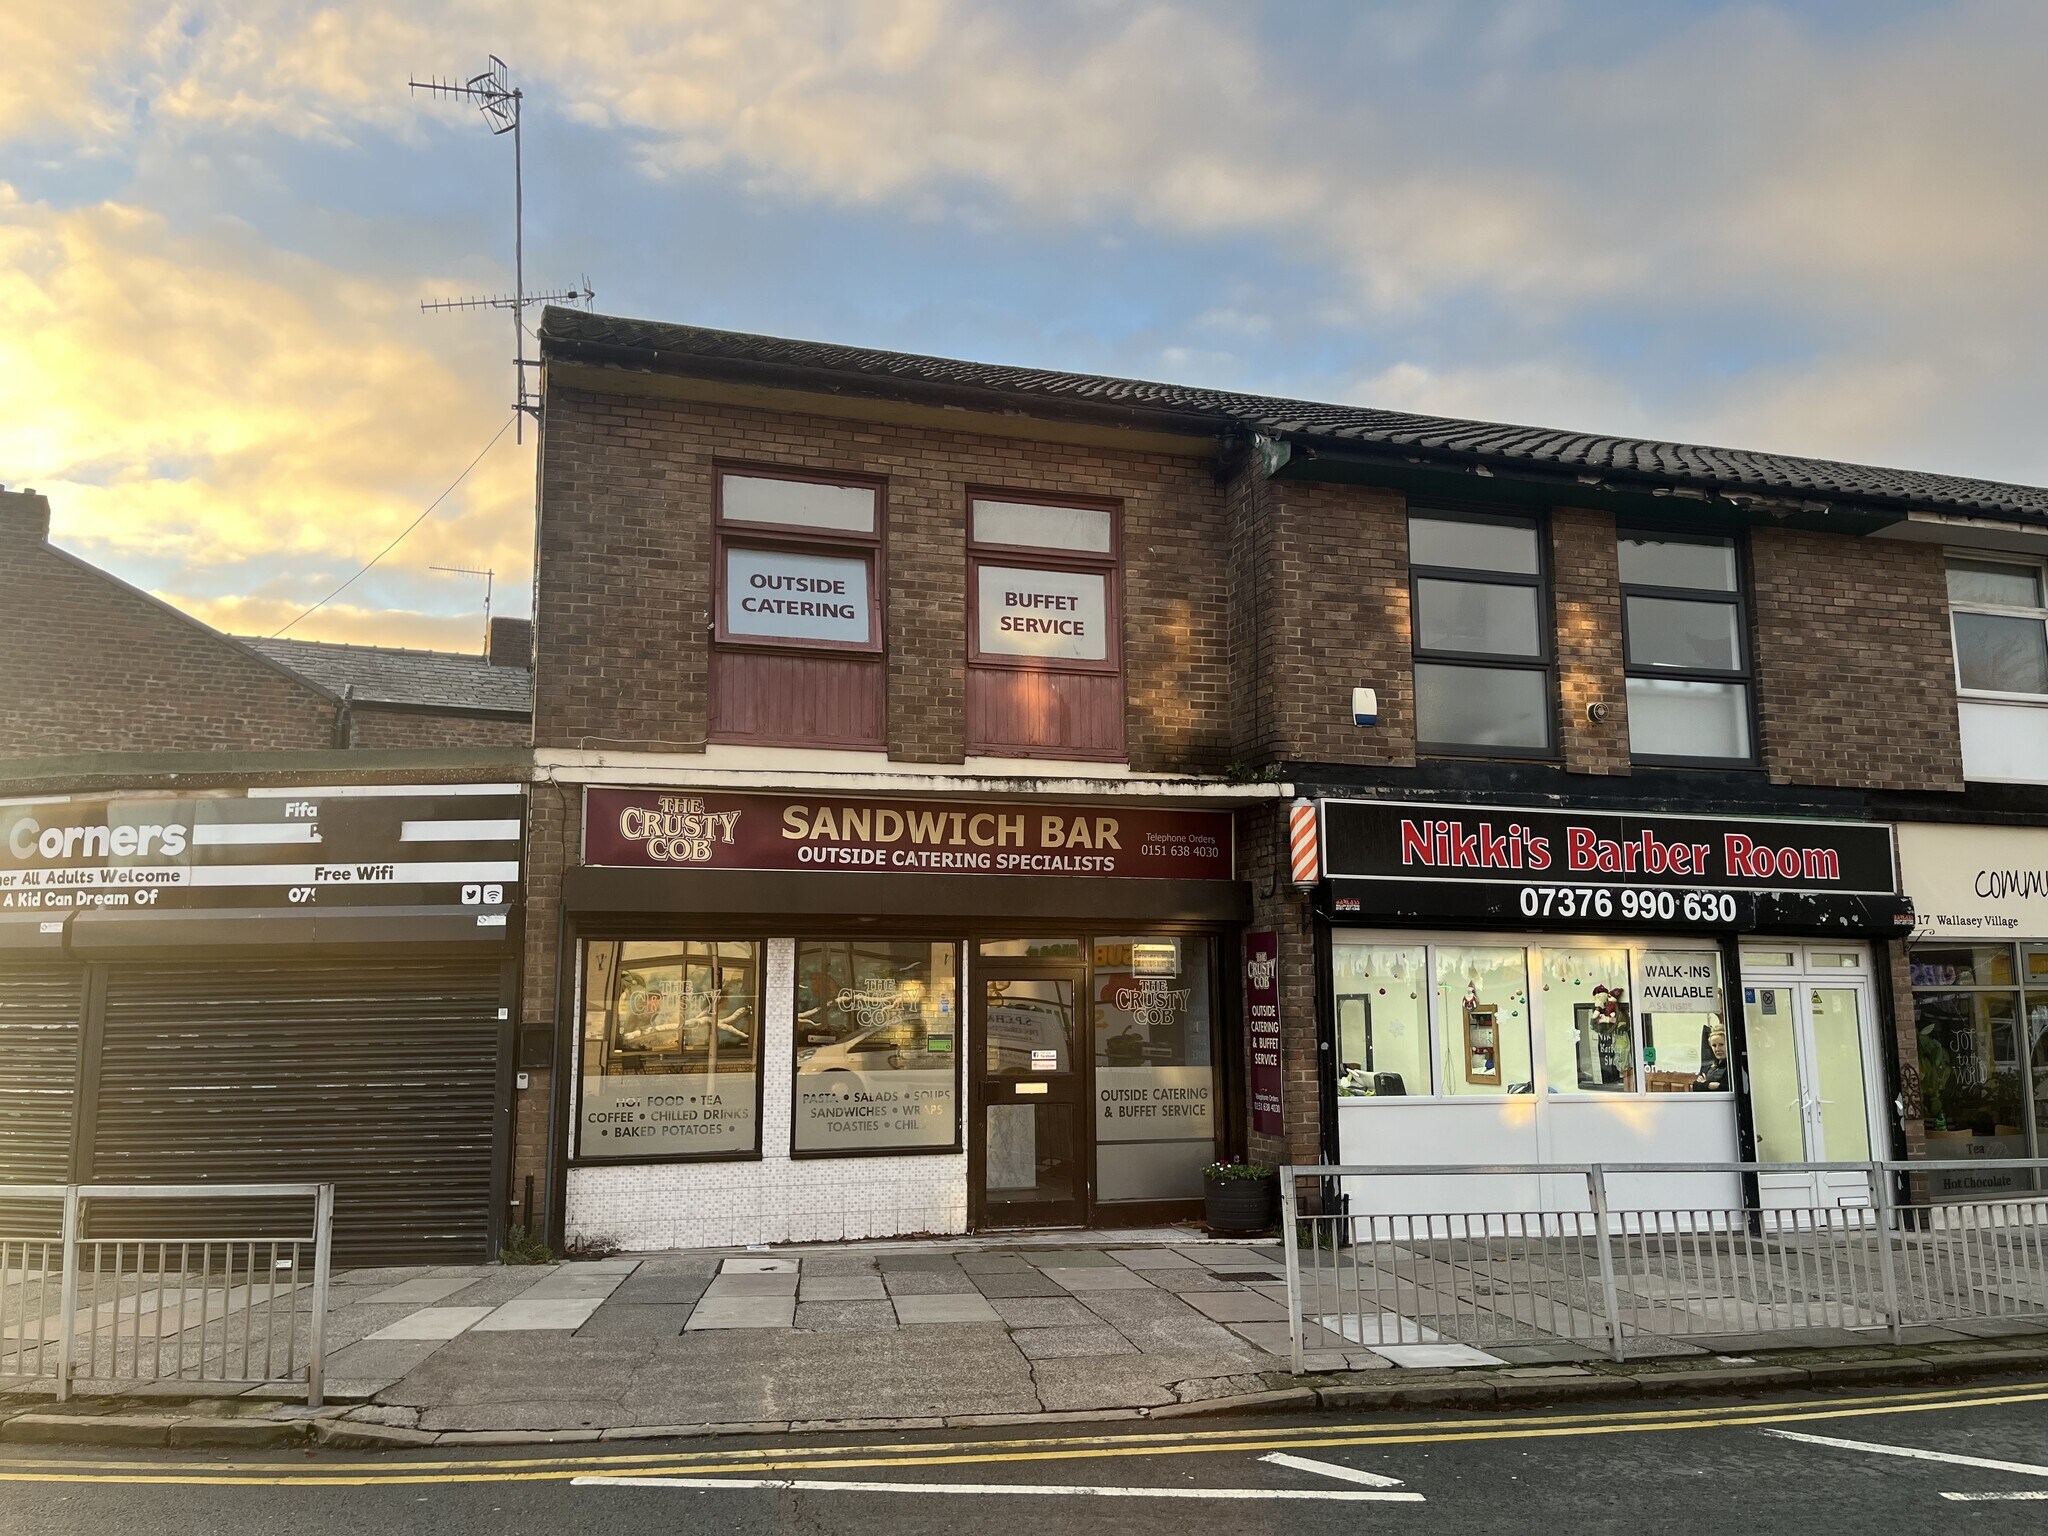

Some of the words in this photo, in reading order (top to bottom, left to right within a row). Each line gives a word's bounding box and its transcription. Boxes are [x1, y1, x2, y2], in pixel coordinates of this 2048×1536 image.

[750, 573, 845, 595] OUTSIDE
[741, 597, 855, 620] CATERING
[1005, 591, 1078, 612] BUFFET
[1000, 616, 1084, 636] SERVICE
[285, 802, 318, 818] Fifa
[659, 796, 703, 815] THE
[620, 806, 741, 844] CRUSTY
[782, 805, 1025, 847] SANDWICH
[1041, 815, 1122, 850] BAR
[9, 817, 187, 860] Corners
[1146, 832, 1186, 844] Telephone
[1188, 834, 1216, 844] Orders
[647, 838, 712, 862] COB
[1141, 844, 1167, 856] 0151
[1170, 845, 1190, 857] 638
[1193, 846, 1219, 858] 4030
[1401, 819, 1551, 871] Nikki's
[1567, 826, 1710, 875] Barber
[1724, 833, 1840, 880] Room
[797, 846, 886, 865] OUTSIDE
[892, 850, 991, 869] CATERING
[996, 853, 1115, 872] SPECIALISTS
[22, 871, 41, 885] All
[46, 870, 94, 884] Adults
[100, 869, 181, 883] Welcome
[315, 867, 351, 881] Free
[356, 865, 394, 881] Wifi
[3, 892, 14, 907] A
[18, 891, 41, 907] Kid
[45, 891, 73, 906] Can
[76, 890, 129, 906] Dream
[134, 889, 159, 905] Of
[1520, 887, 1613, 918] 07376
[1621, 889, 1675, 920] 990
[1684, 892, 1737, 923] 630
[1937, 915, 1982, 928] Wallasey
[1984, 916, 2018, 929] Village
[1248, 958, 1276, 978] CRUSTY
[1645, 965, 1711, 978] WALK-INS
[659, 980, 694, 994] THE
[864, 979, 896, 991] THE
[1139, 980, 1168, 992] THE
[1254, 977, 1270, 989] COB
[1644, 986, 1713, 998] AVAILABLE
[1116, 988, 1191, 1012] CRUSTY
[1133, 1009, 1174, 1025] COB
[1252, 1005, 1276, 1017] OUTSIDE
[1251, 1021, 1279, 1033] CATERING
[1259, 1038, 1279, 1049] BUFFET
[1255, 1053, 1277, 1066] SERVICE
[647, 1096, 684, 1106] FOOD
[701, 1095, 722, 1105] TEA
[854, 1092, 898, 1102] SALADS
[914, 1090, 950, 1101] SOUPS
[1101, 1089, 1148, 1101] OUTSIDE
[1153, 1088, 1208, 1100] CATERING
[588, 1112, 633, 1123] COFFEE
[651, 1110, 698, 1121] CHILLED
[703, 1109, 749, 1120] DRINKS
[811, 1106, 887, 1118] SANDWICHES
[1104, 1106, 1112, 1117] &
[1119, 1105, 1156, 1117] BUFFET
[1162, 1104, 1206, 1116] SERVICE
[614, 1126, 656, 1138] BAKED
[662, 1124, 722, 1136] POTATOES
[827, 1120, 879, 1132] TOASTIES
[1966, 1144, 1985, 1154] Tea
[1943, 1178, 1962, 1190] Hot
[1964, 1176, 2012, 1189] Chocolate
